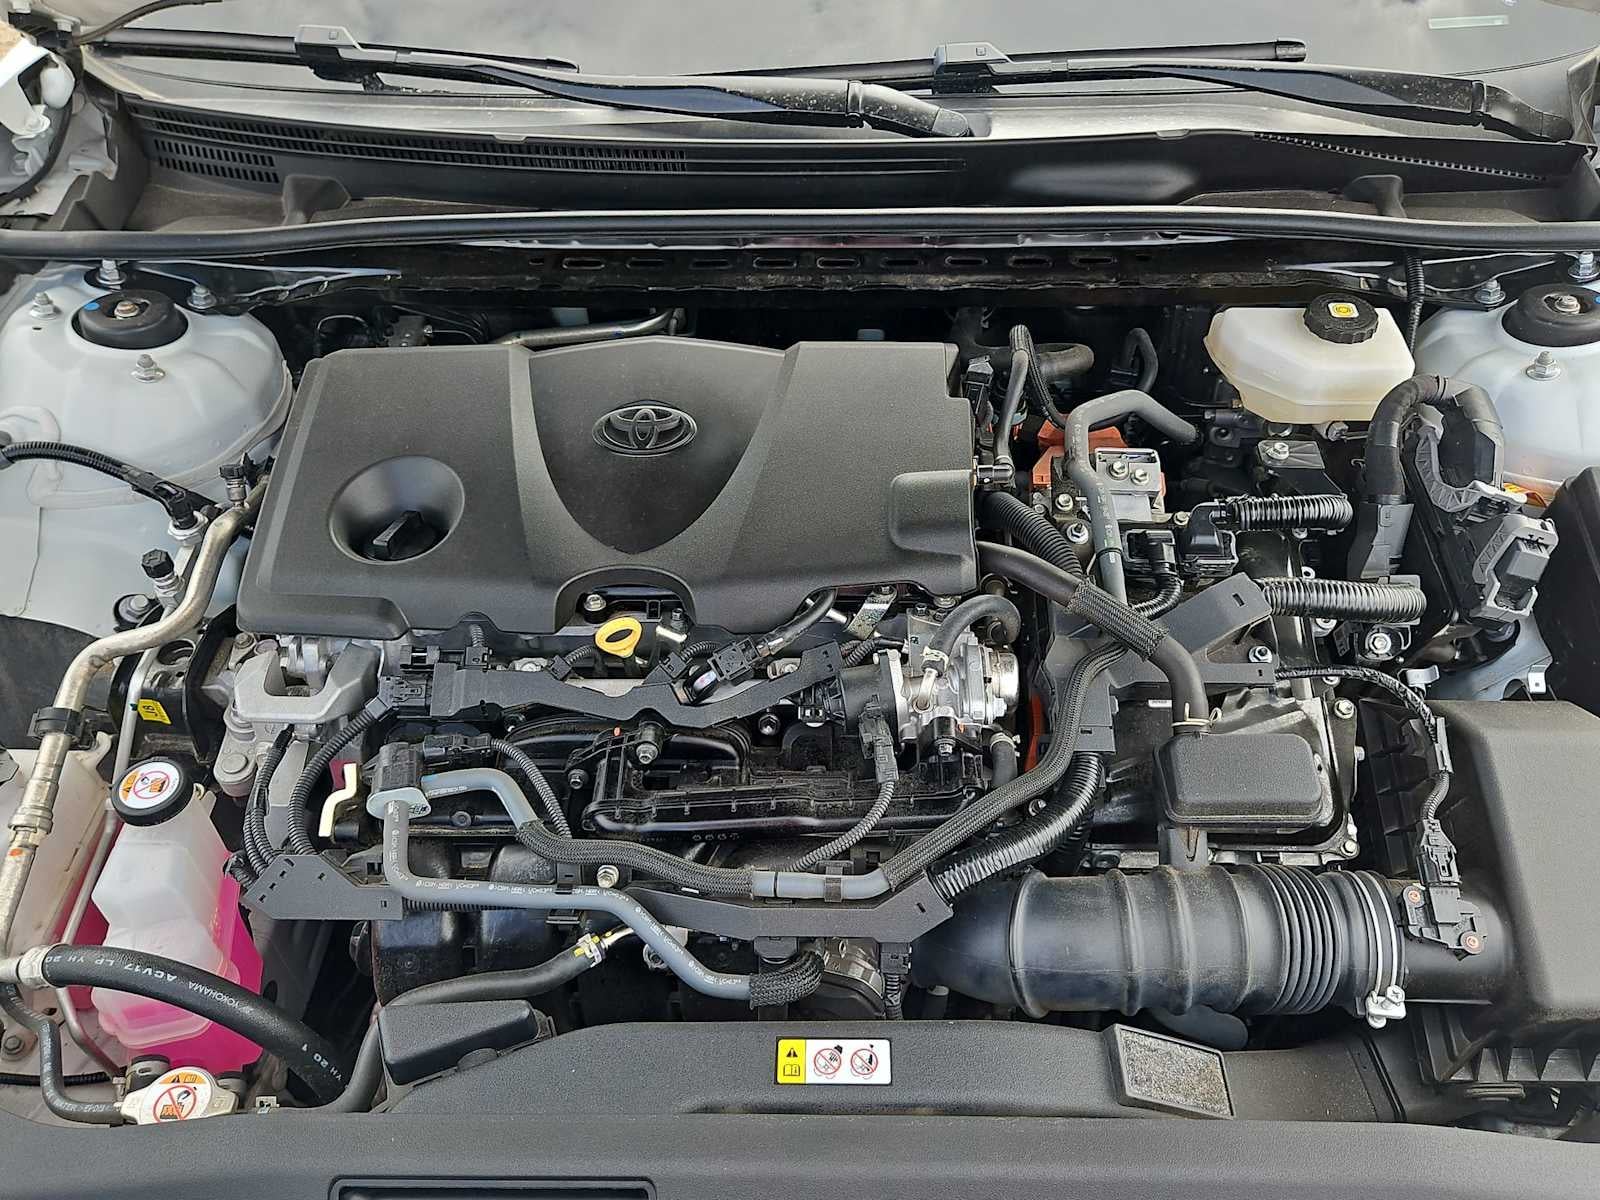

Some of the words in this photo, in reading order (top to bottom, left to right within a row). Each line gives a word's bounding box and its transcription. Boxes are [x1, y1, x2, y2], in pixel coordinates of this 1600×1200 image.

[67, 955, 86, 964] YH
[94, 957, 115, 967] LP
[124, 962, 178, 983] ACV17
[187, 980, 242, 1009] YOKOHAMA
[313, 1052, 329, 1068] 20
[329, 1066, 342, 1081] YH
